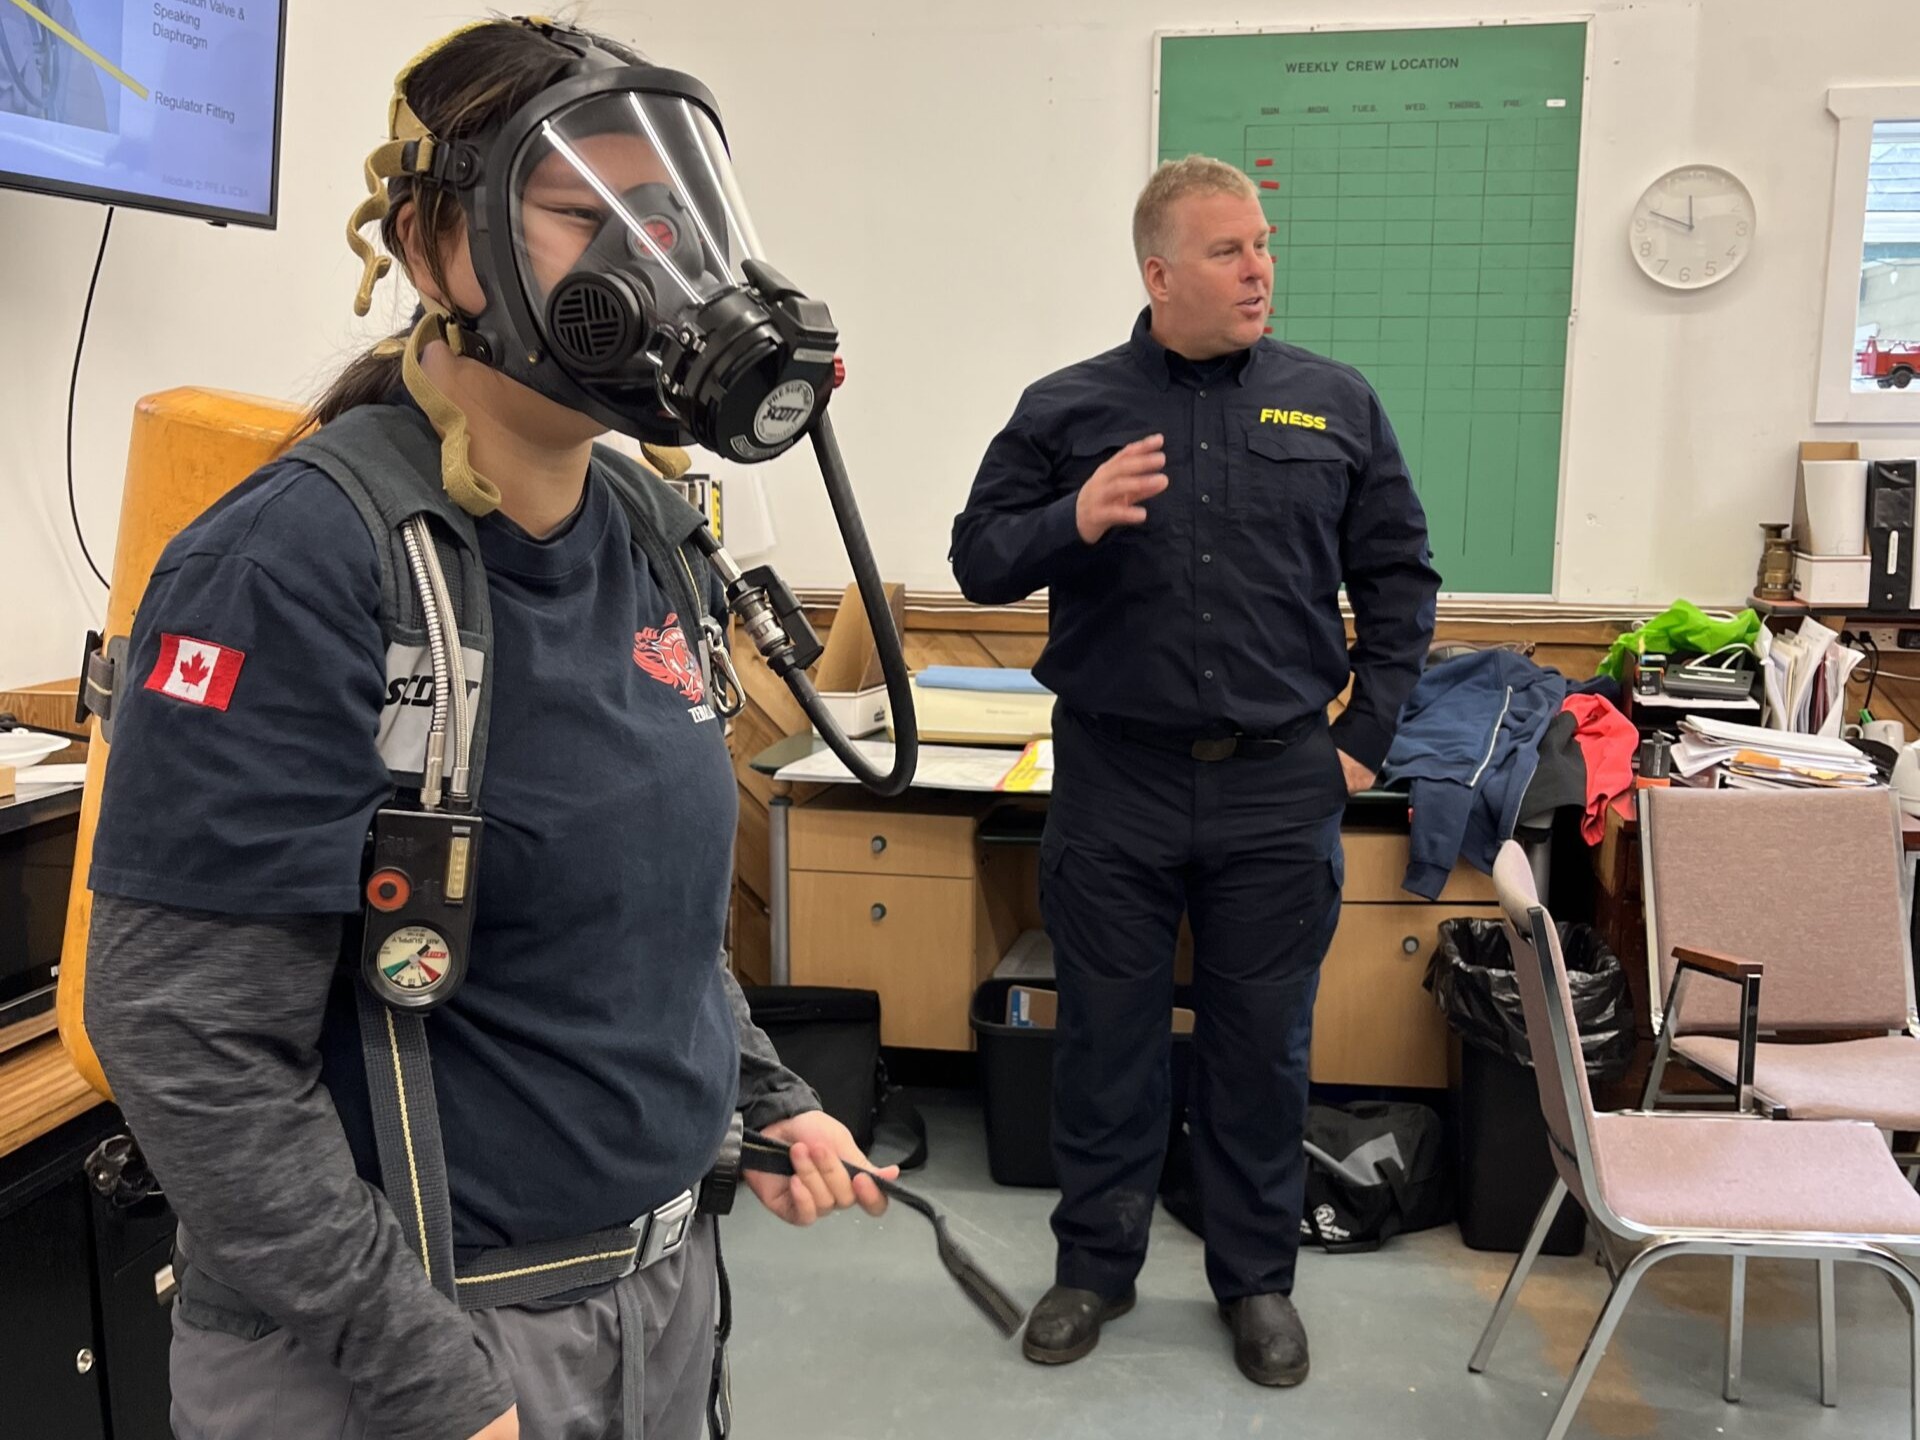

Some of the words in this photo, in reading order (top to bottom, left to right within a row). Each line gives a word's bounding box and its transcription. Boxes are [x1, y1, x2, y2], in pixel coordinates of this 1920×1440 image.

[153, 2, 201, 31] Speaking
[209, 0, 236, 17] Valve
[152, 22, 208, 50] Diaphragm
[1285, 61, 1339, 74] WEEKLY
[1346, 59, 1386, 72] CREW
[1391, 57, 1459, 71] LOCATION
[155, 90, 203, 114] Regulator
[205, 103, 235, 124] Fitting
[1735, 220, 1749, 237] 3
[1639, 240, 1652, 258] 8
[1725, 244, 1737, 261] 4
[1656, 258, 1670, 276] 7
[1679, 266, 1692, 283] 6
[1703, 260, 1718, 277] 5
[1260, 408, 1327, 430] FNESS
[385, 675, 480, 707] SCOT
[392, 935, 424, 945] SUPPLY
